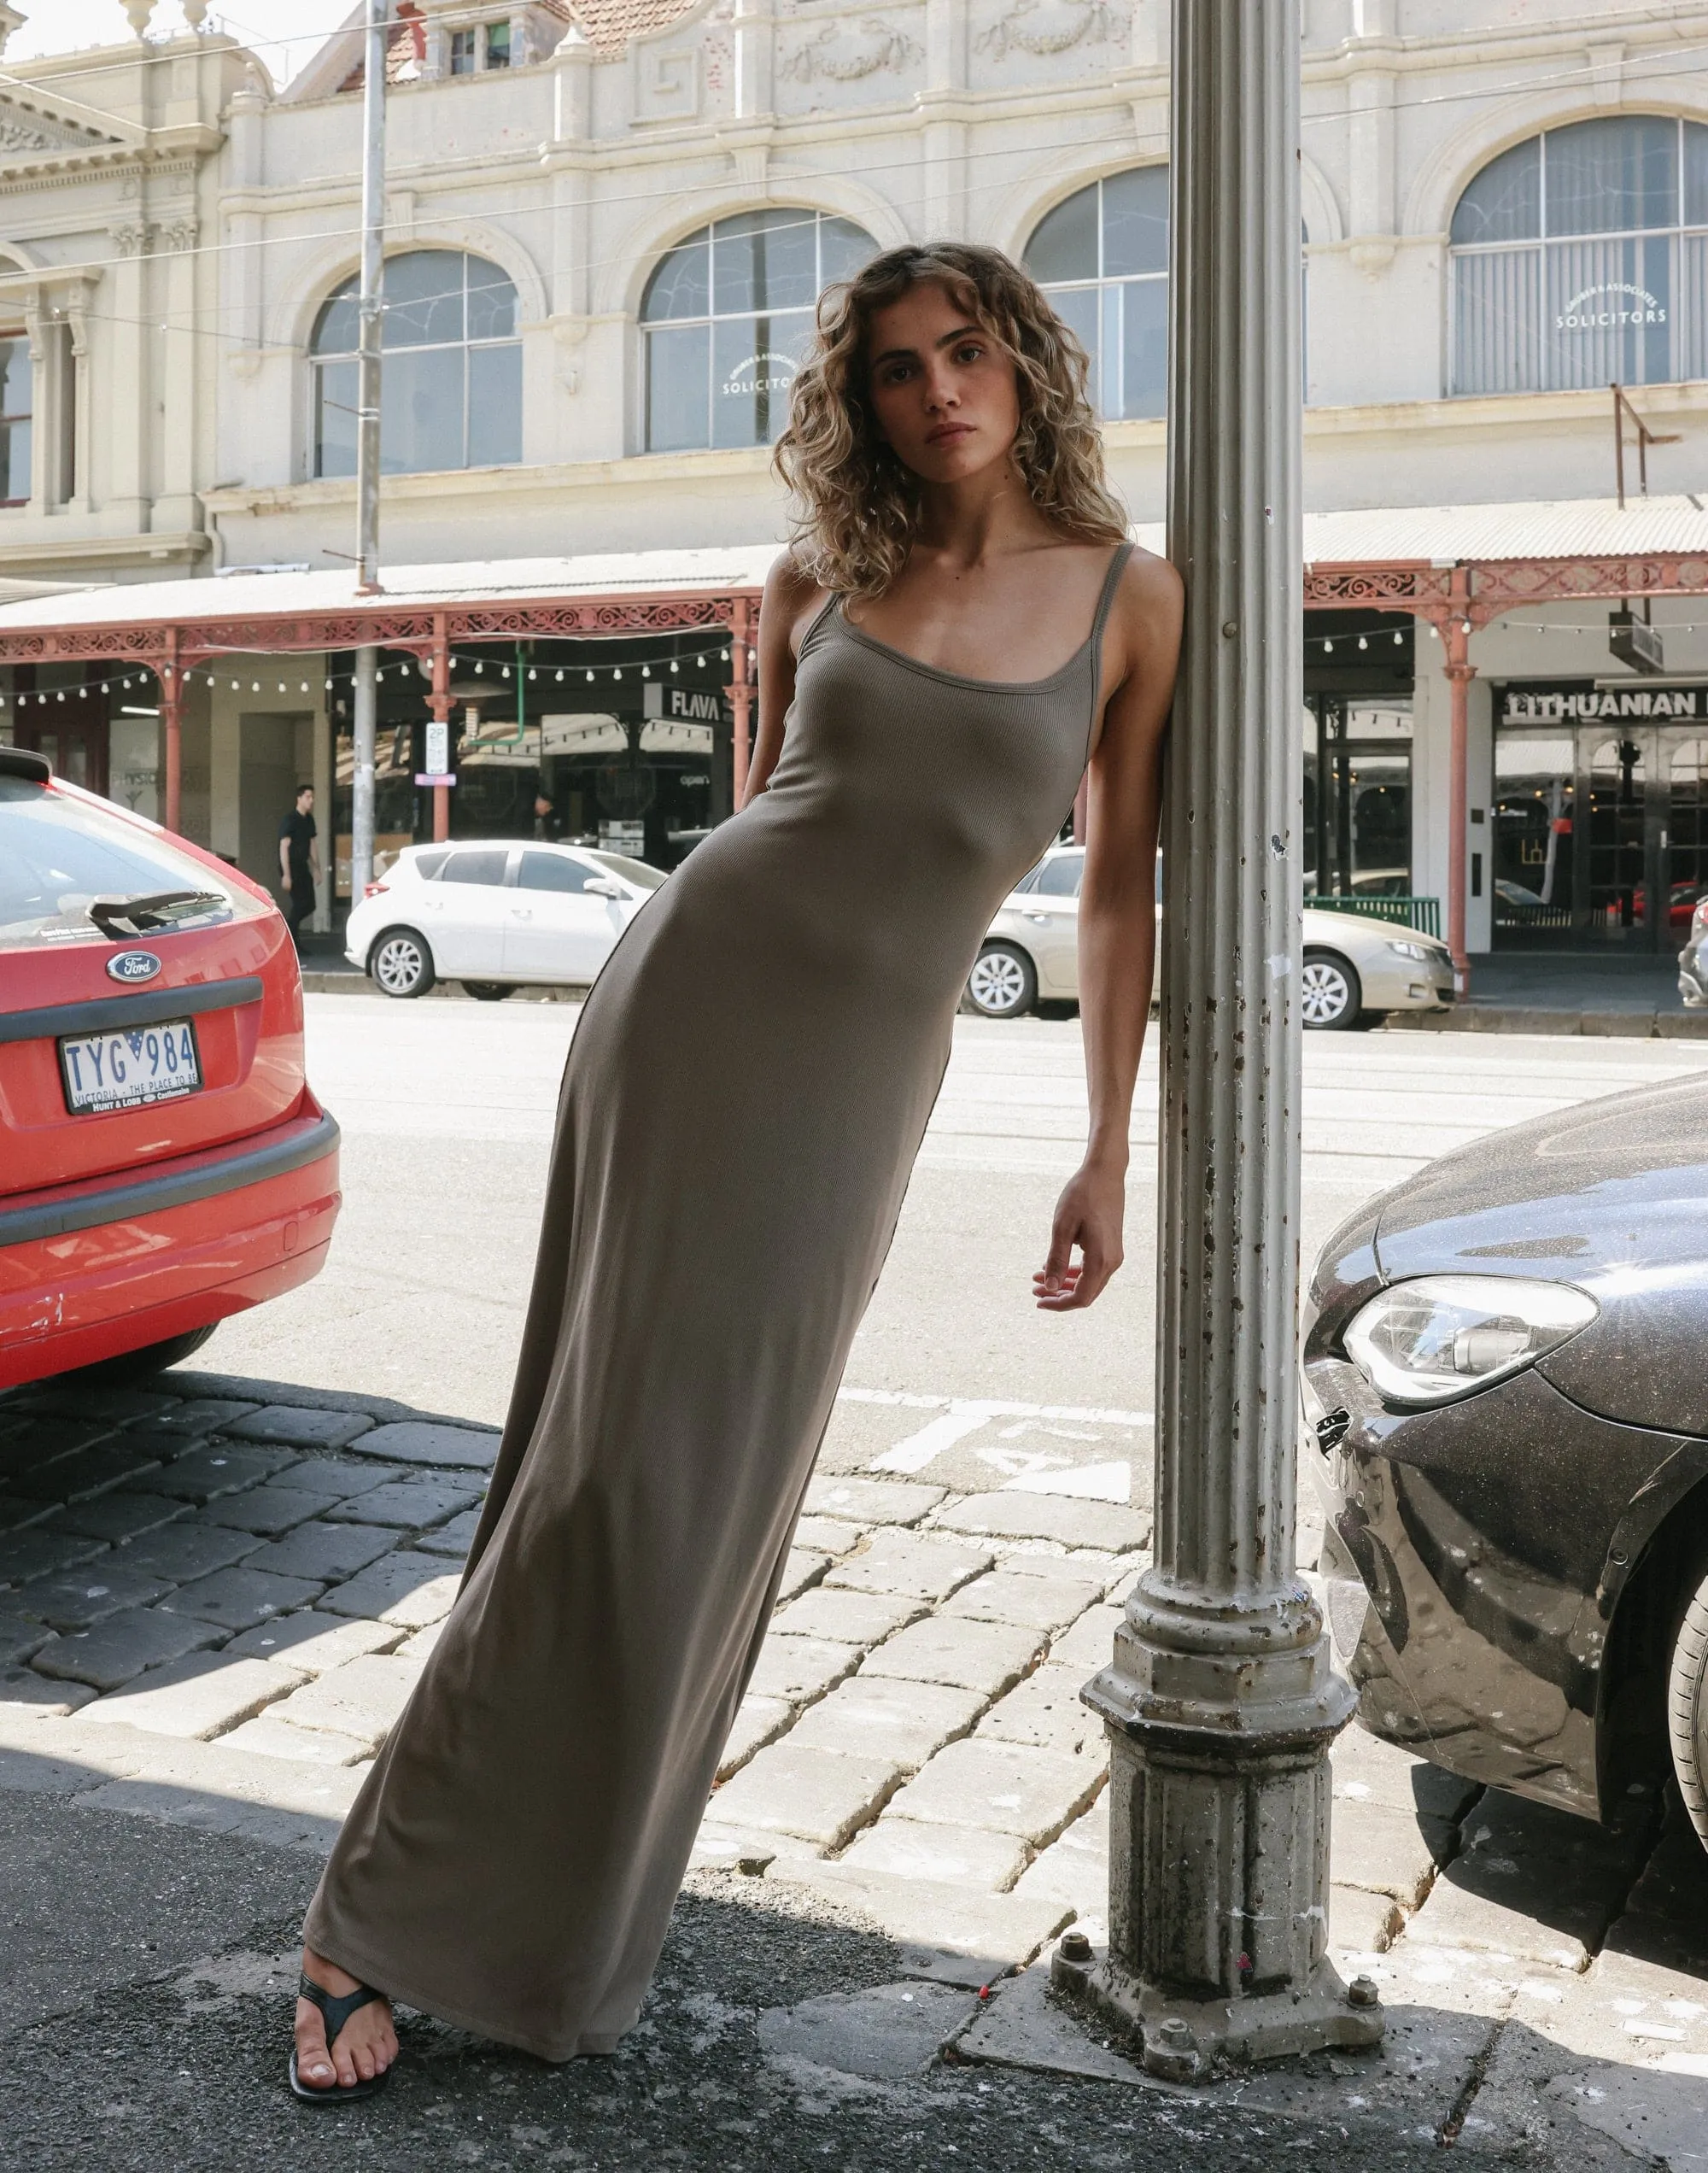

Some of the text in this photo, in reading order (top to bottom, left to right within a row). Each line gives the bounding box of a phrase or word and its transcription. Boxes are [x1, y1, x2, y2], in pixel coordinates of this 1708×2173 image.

[1606, 282, 1658, 308] ASSOCIATES
[1556, 309, 1666, 329] SOLICITORS
[671, 690, 719, 720] FLAVA
[1508, 692, 1696, 717] LITHUANIAN
[430, 728, 444, 740] 2P
[124, 957, 151, 975] Ford
[67, 1028, 193, 1091] TYG 984
[75, 1089, 119, 1104] VICTORIA
[129, 1084, 144, 1095] THE
[149, 1078, 173, 1091] PLACE
[176, 1075, 185, 1086] TO
[189, 1073, 197, 1084] BE
[92, 1102, 114, 1112] HUNT
